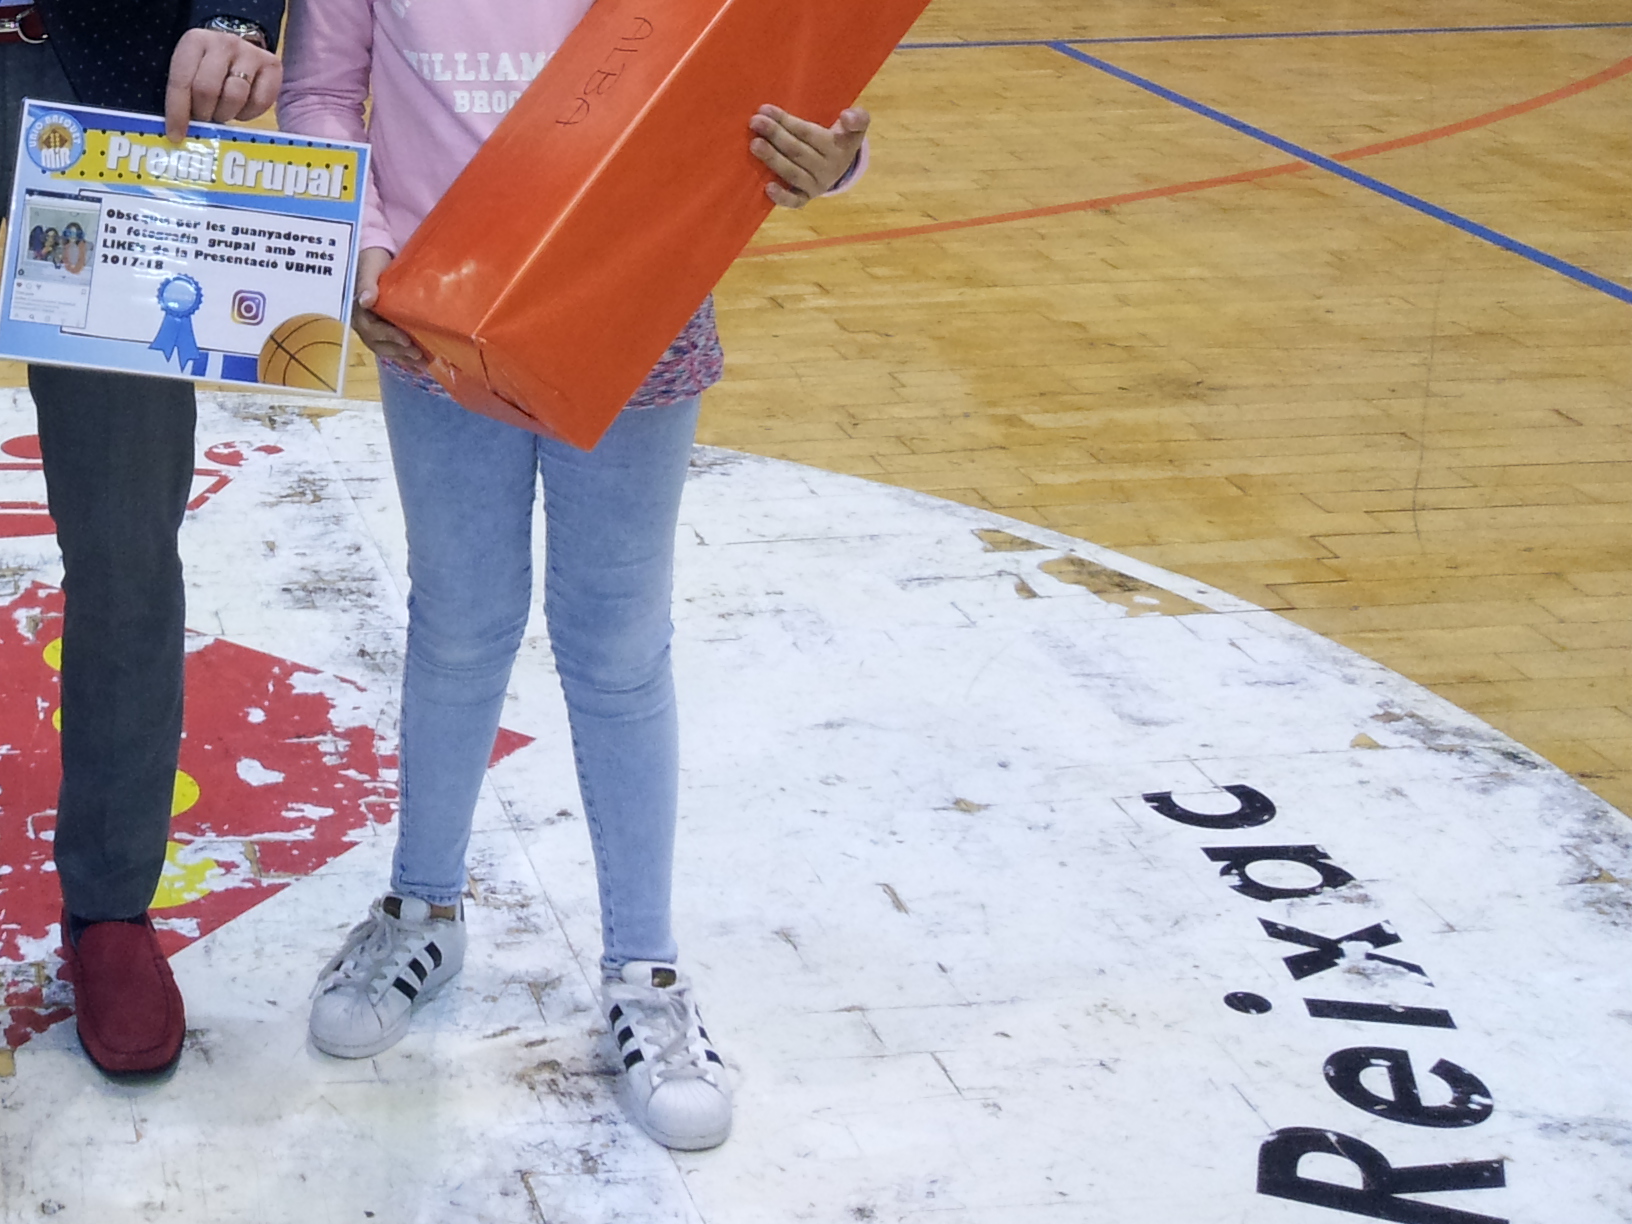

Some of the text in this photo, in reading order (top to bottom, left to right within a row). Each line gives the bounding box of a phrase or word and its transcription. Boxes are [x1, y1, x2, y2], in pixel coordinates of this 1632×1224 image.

[403, 50, 557, 82] ILLIAM
[106, 135, 344, 199] Premi Grupal
[104, 223, 118, 235] la
[208, 237, 256, 252] grupal
[264, 243, 296, 257] amb
[206, 221, 226, 233] les
[231, 225, 323, 246] guanyadores
[328, 237, 337, 247] a
[101, 253, 164, 271] 2017-18
[175, 247, 188, 259] la
[194, 249, 278, 270] Presentació
[285, 261, 334, 277] UBMIR
[1142, 784, 1510, 1224] Reixac
